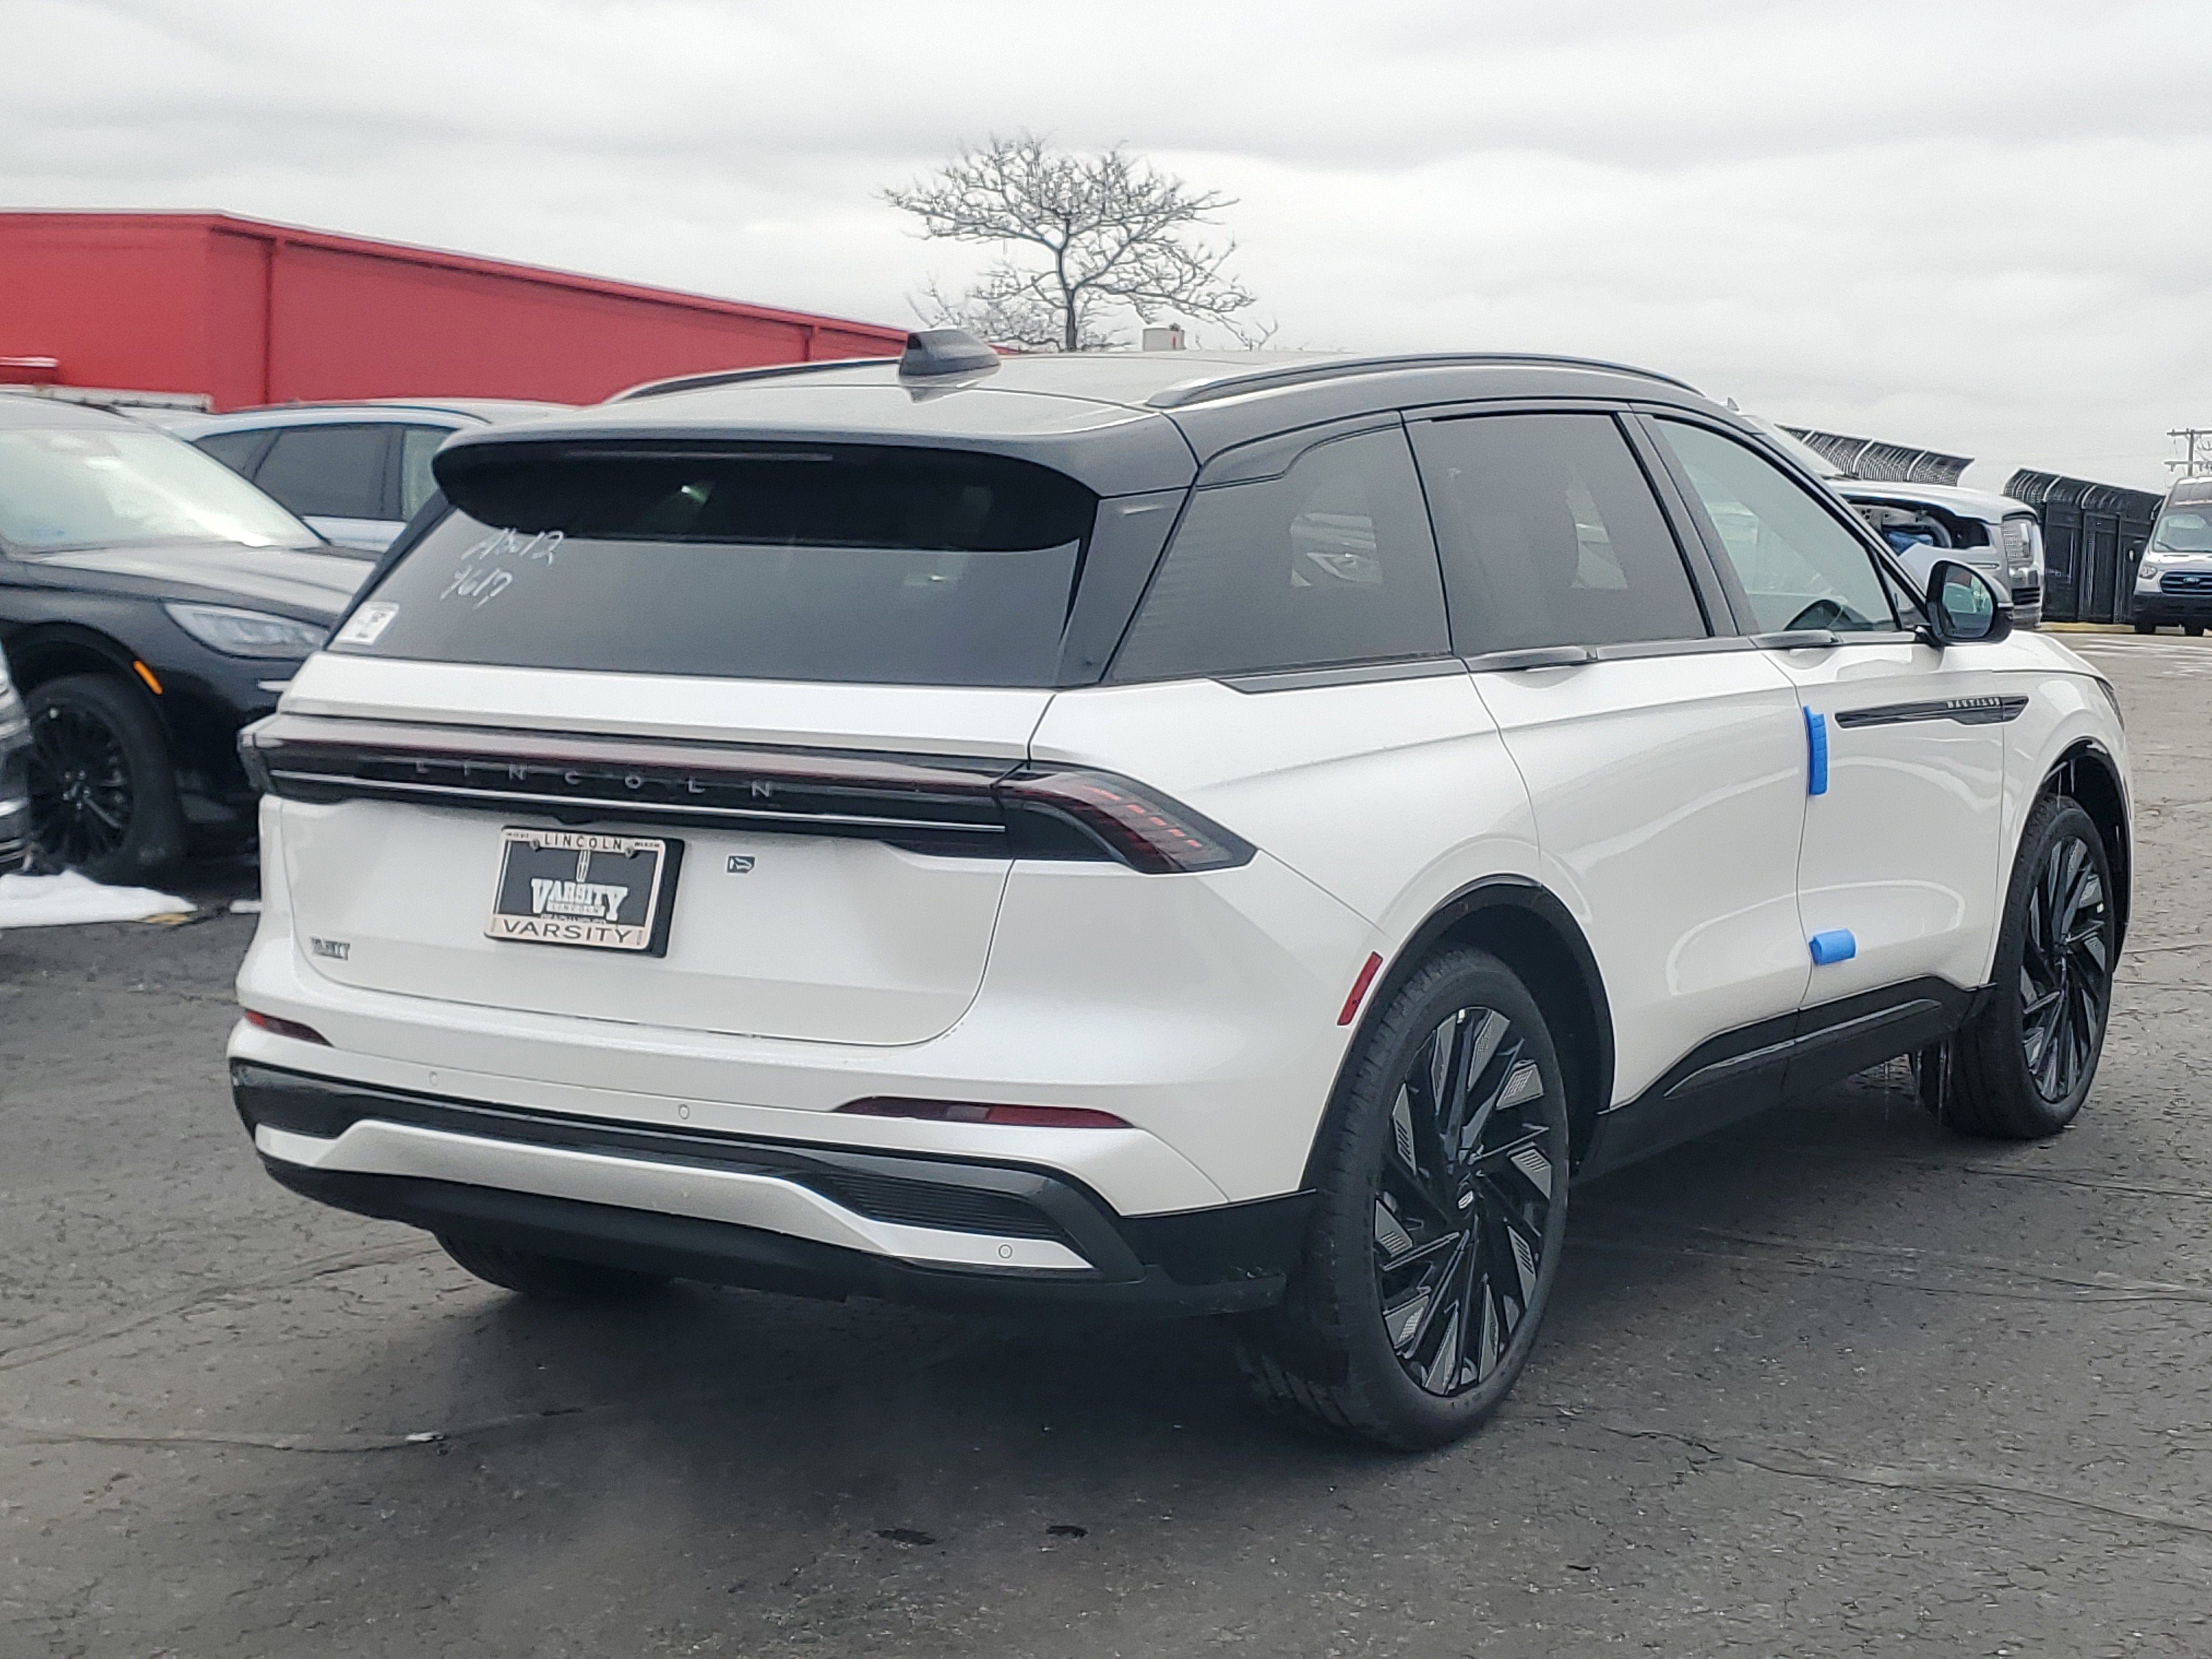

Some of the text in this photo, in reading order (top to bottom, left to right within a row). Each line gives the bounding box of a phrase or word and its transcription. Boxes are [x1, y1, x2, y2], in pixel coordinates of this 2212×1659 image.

[415, 761, 770, 797] LINCOLN
[544, 833, 622, 850] LINCOLN
[530, 878, 628, 921] VARSITY
[503, 918, 633, 944] VARSITY
